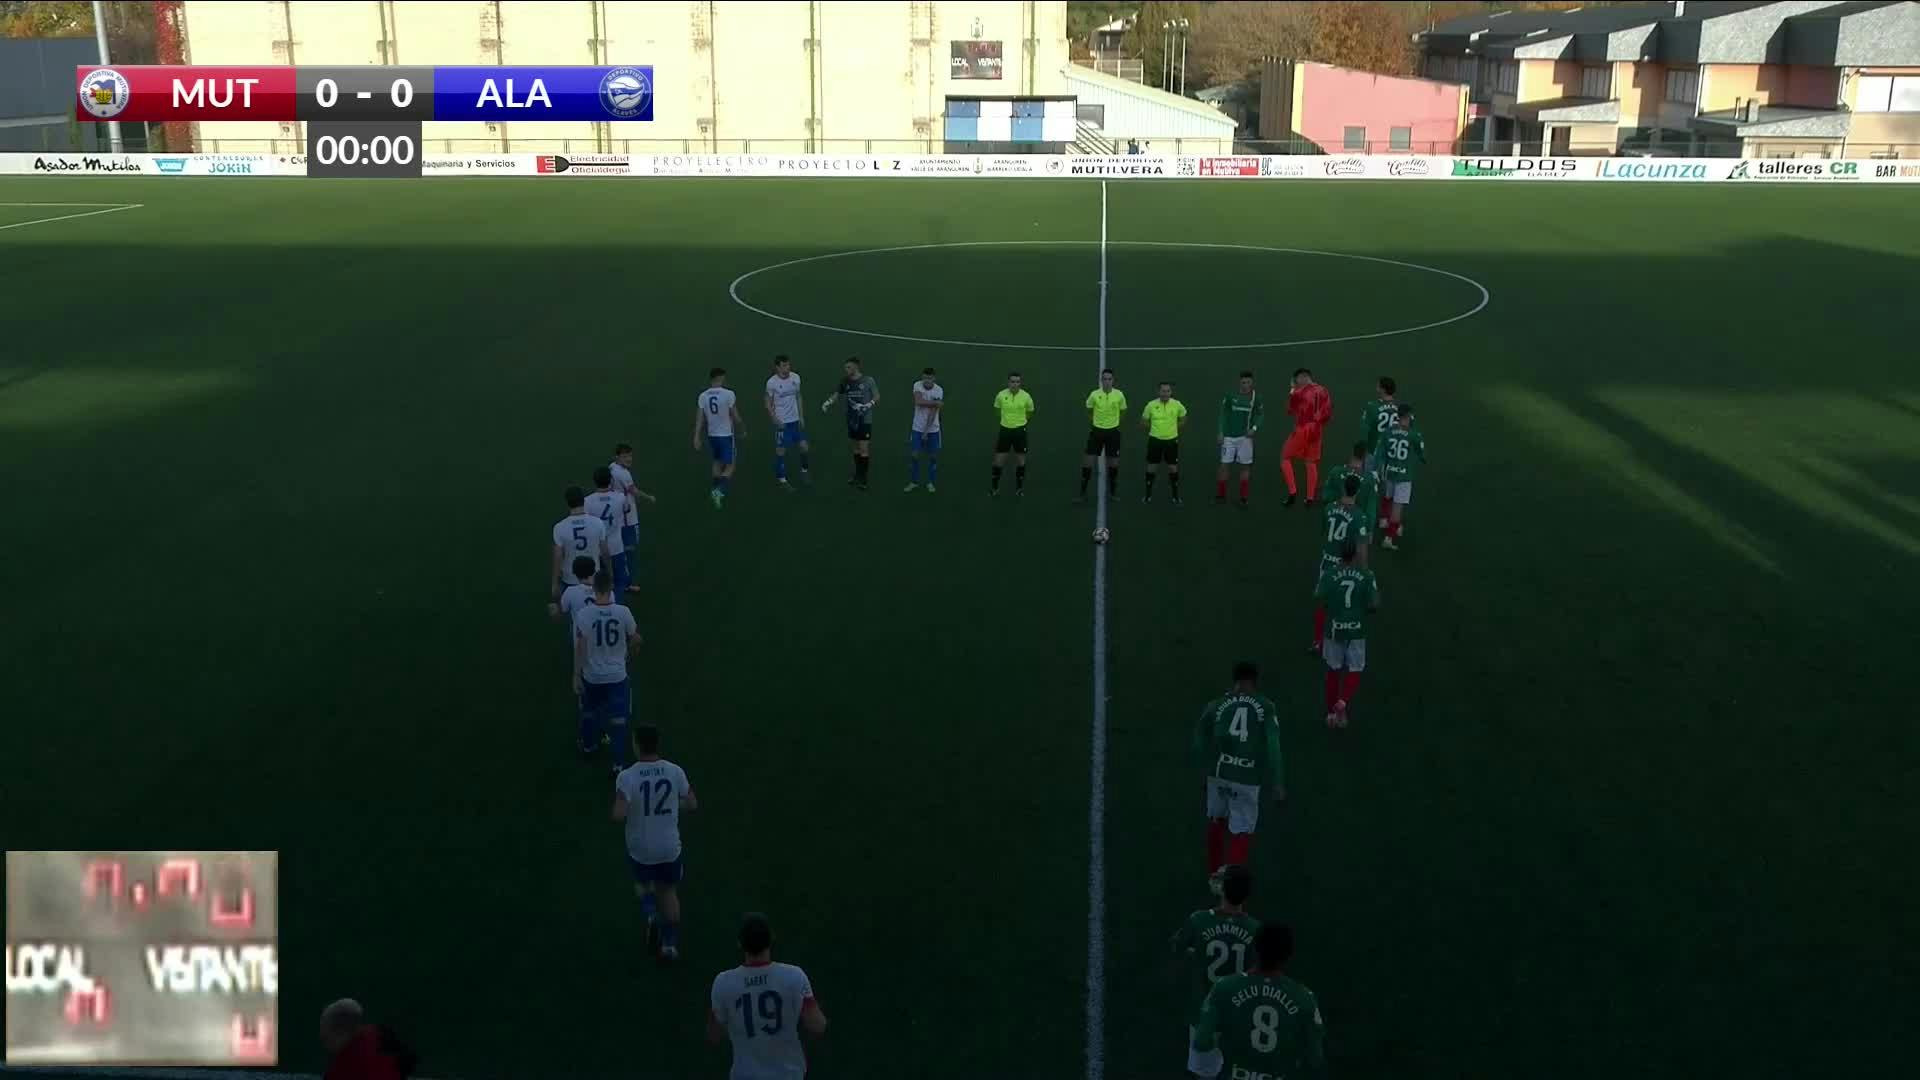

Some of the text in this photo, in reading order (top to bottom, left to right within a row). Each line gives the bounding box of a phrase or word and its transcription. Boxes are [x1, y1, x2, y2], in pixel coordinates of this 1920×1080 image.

[467, 160, 472, 169] y
[475, 160, 516, 168] Servicios
[779, 159, 866, 170] PROYECTO
[1071, 166, 1163, 174] MUTILVERA
[1460, 159, 1577, 170] TOLDOS
[1603, 160, 1707, 178] Lacunza
[1759, 161, 1857, 175] talleres CR
[1875, 165, 1897, 177] BAR
[709, 396, 719, 415] 6
[1387, 438, 1409, 461] 36
[600, 503, 615, 525] 4
[573, 526, 588, 551] 5
[1328, 516, 1349, 542] 14
[1340, 579, 1356, 609] 7
[592, 619, 620, 647] 16
[1228, 706, 1249, 742] 4
[639, 778, 672, 817] 12
[1206, 940, 1248, 983] 21
[1262, 984, 1299, 1016] DIALLO
[735, 990, 783, 1038] 19
[1250, 1004, 1279, 1054] 8
